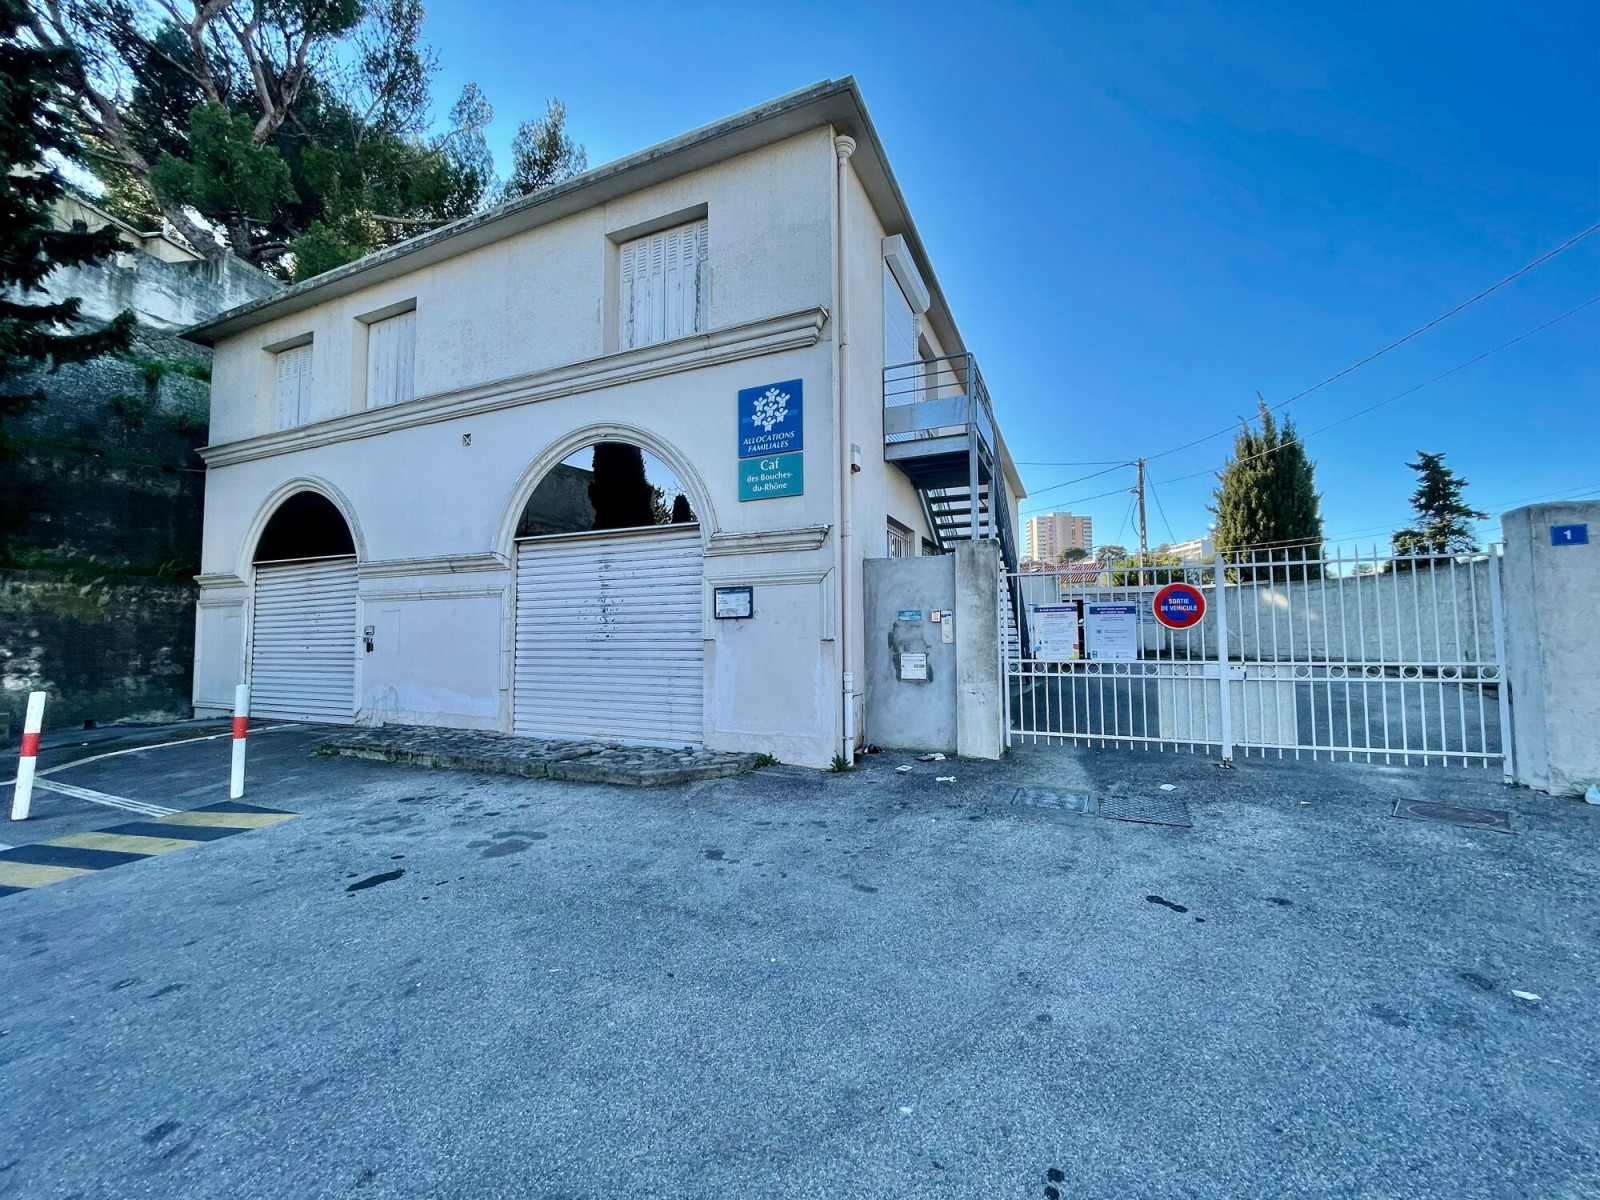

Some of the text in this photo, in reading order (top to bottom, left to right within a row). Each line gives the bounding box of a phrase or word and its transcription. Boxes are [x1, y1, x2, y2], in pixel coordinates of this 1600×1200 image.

[742, 430, 796, 446] ALLOCATIONS
[747, 439, 789, 453] FAMILIALES
[760, 457, 780, 471] Caf
[746, 471, 793, 483] des Bouches-
[752, 482, 788, 492] du-Rhône
[1563, 529, 1572, 540] 1
